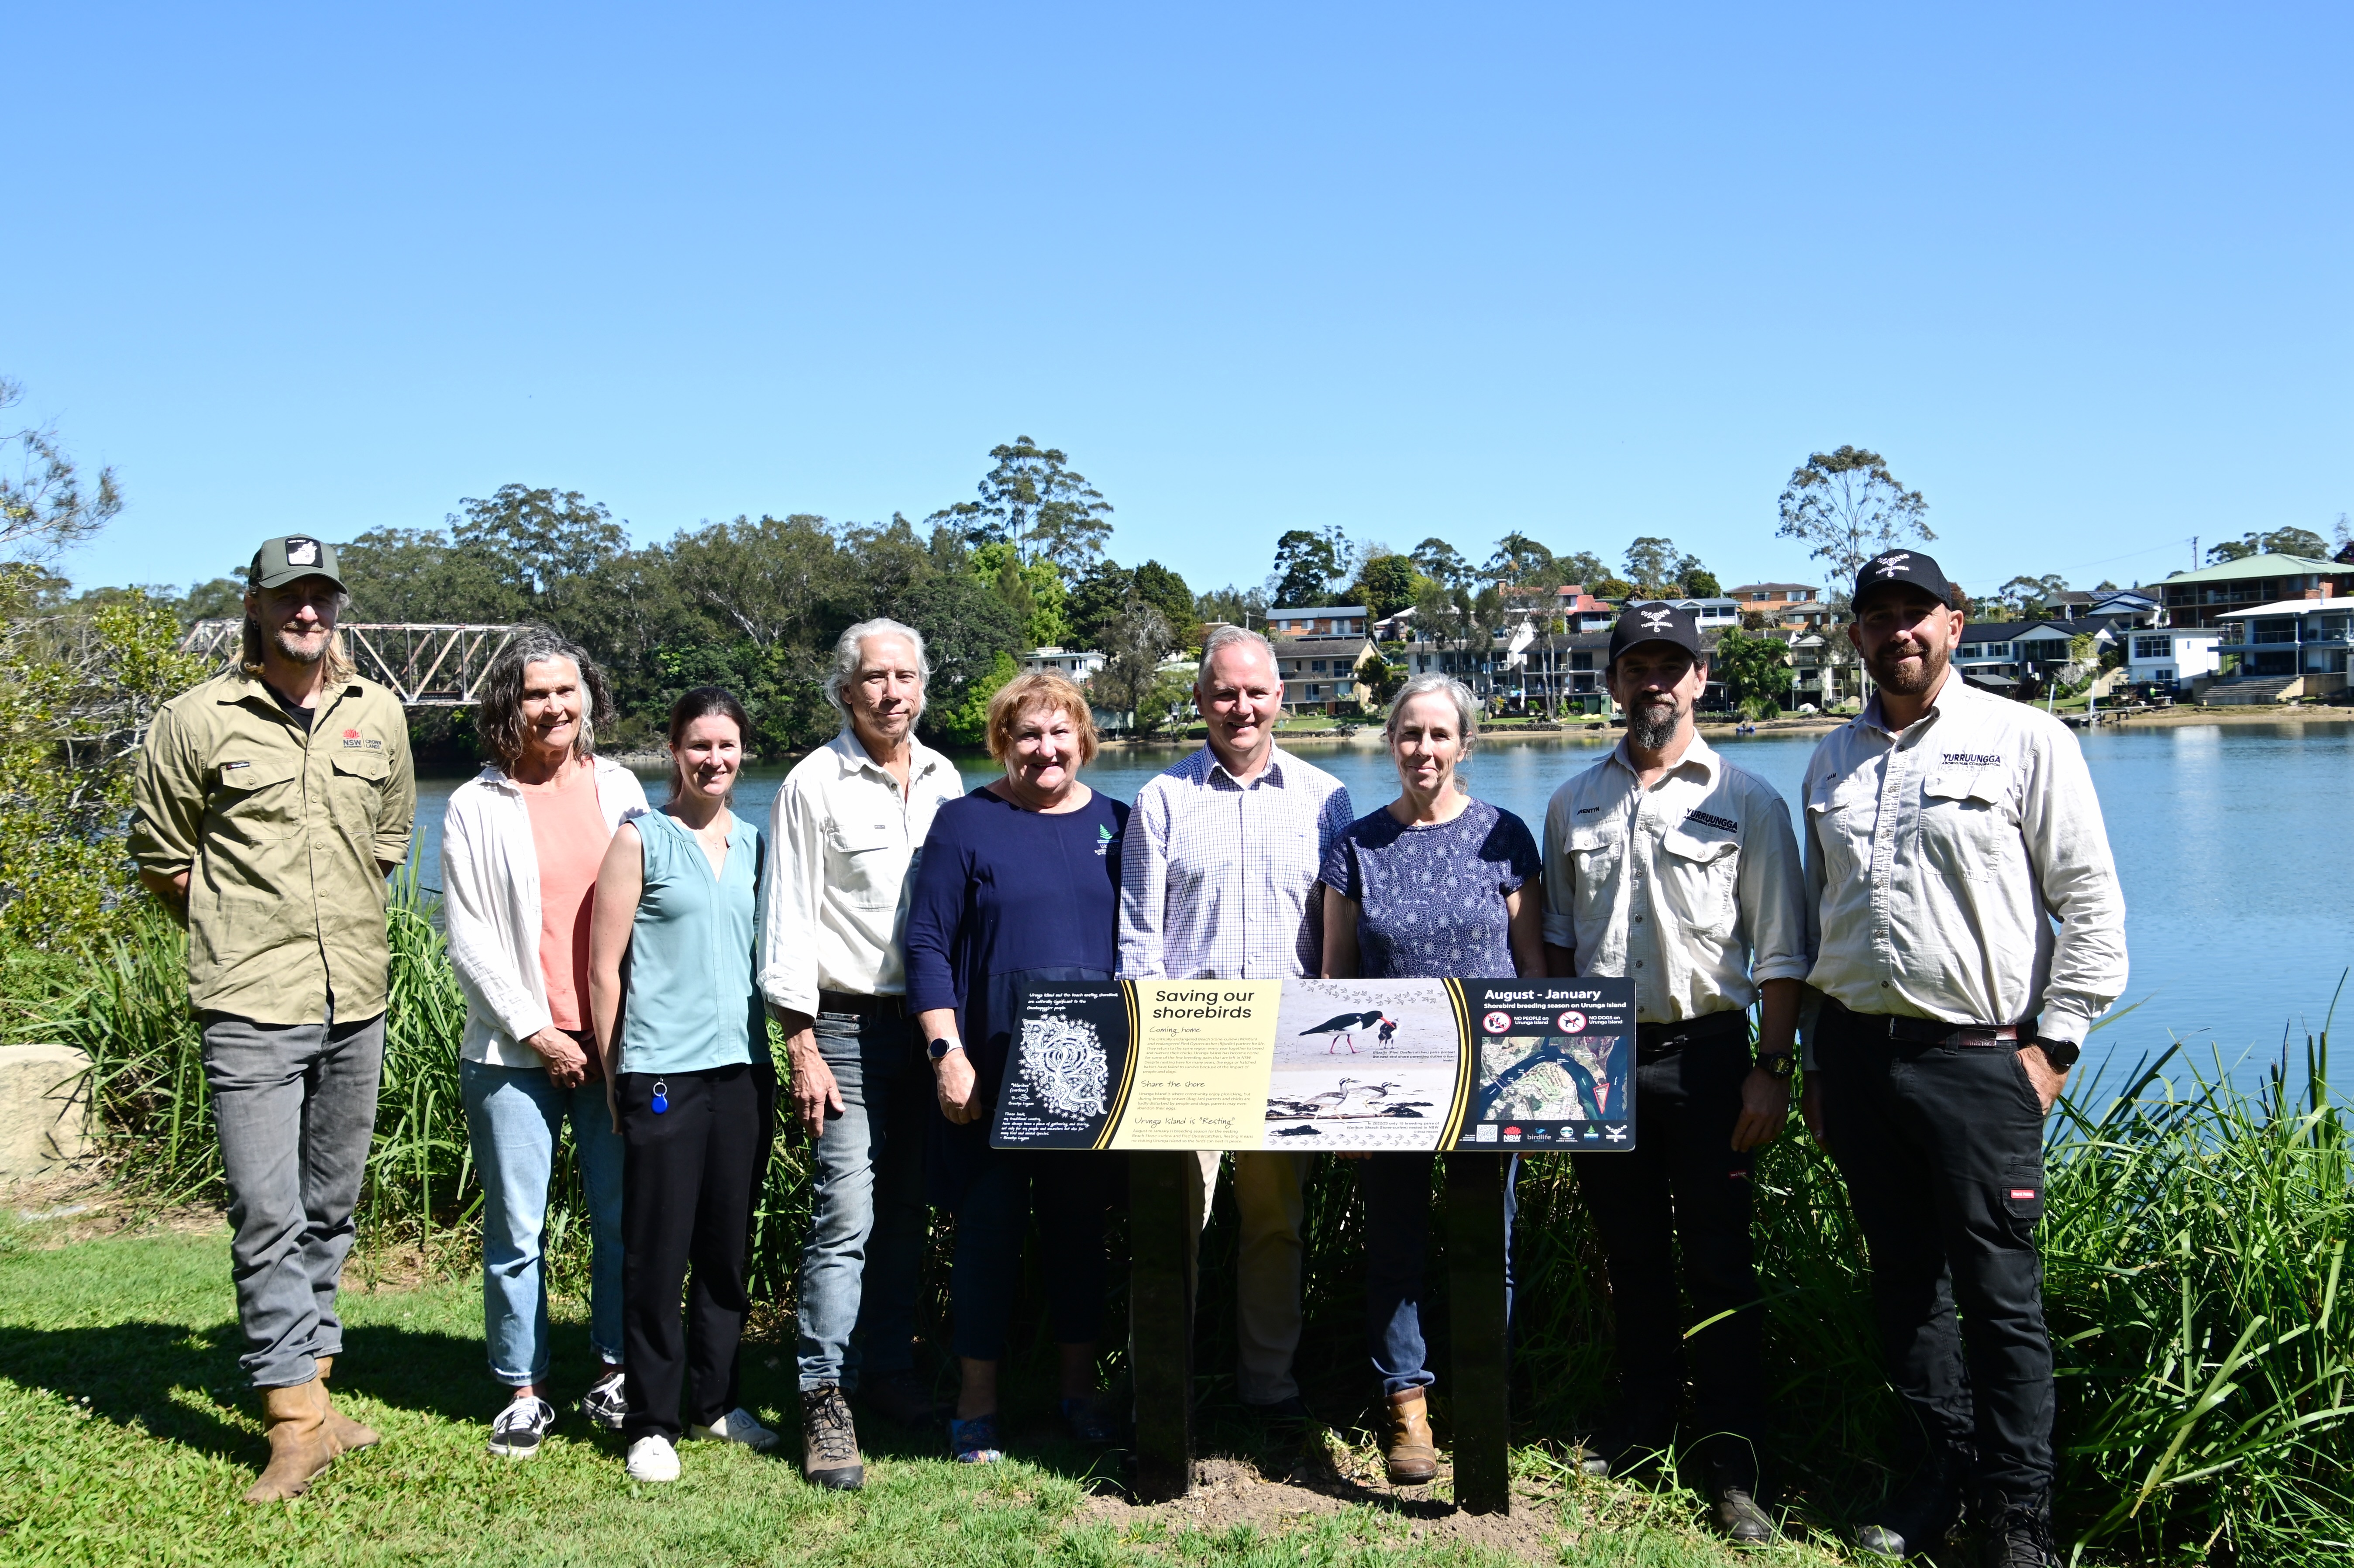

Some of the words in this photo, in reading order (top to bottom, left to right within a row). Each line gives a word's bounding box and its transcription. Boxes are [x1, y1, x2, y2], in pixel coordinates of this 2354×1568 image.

[1943, 753, 2000, 763] YURRUUNGGA
[1683, 815, 1708, 826] ABORIGINAL
[1708, 823, 1737, 834] CORPORATION
[1687, 808, 1738, 830] YURRUUNGGA
[1156, 989, 1218, 1005] Saving
[1224, 992, 1255, 1001] our
[1484, 990, 1534, 1002] August
[1545, 989, 1601, 1001] January
[1153, 1006, 1251, 1018] shorebirds
[1149, 1026, 1180, 1037] Coming
[1135, 1117, 1161, 1128] Urunga
